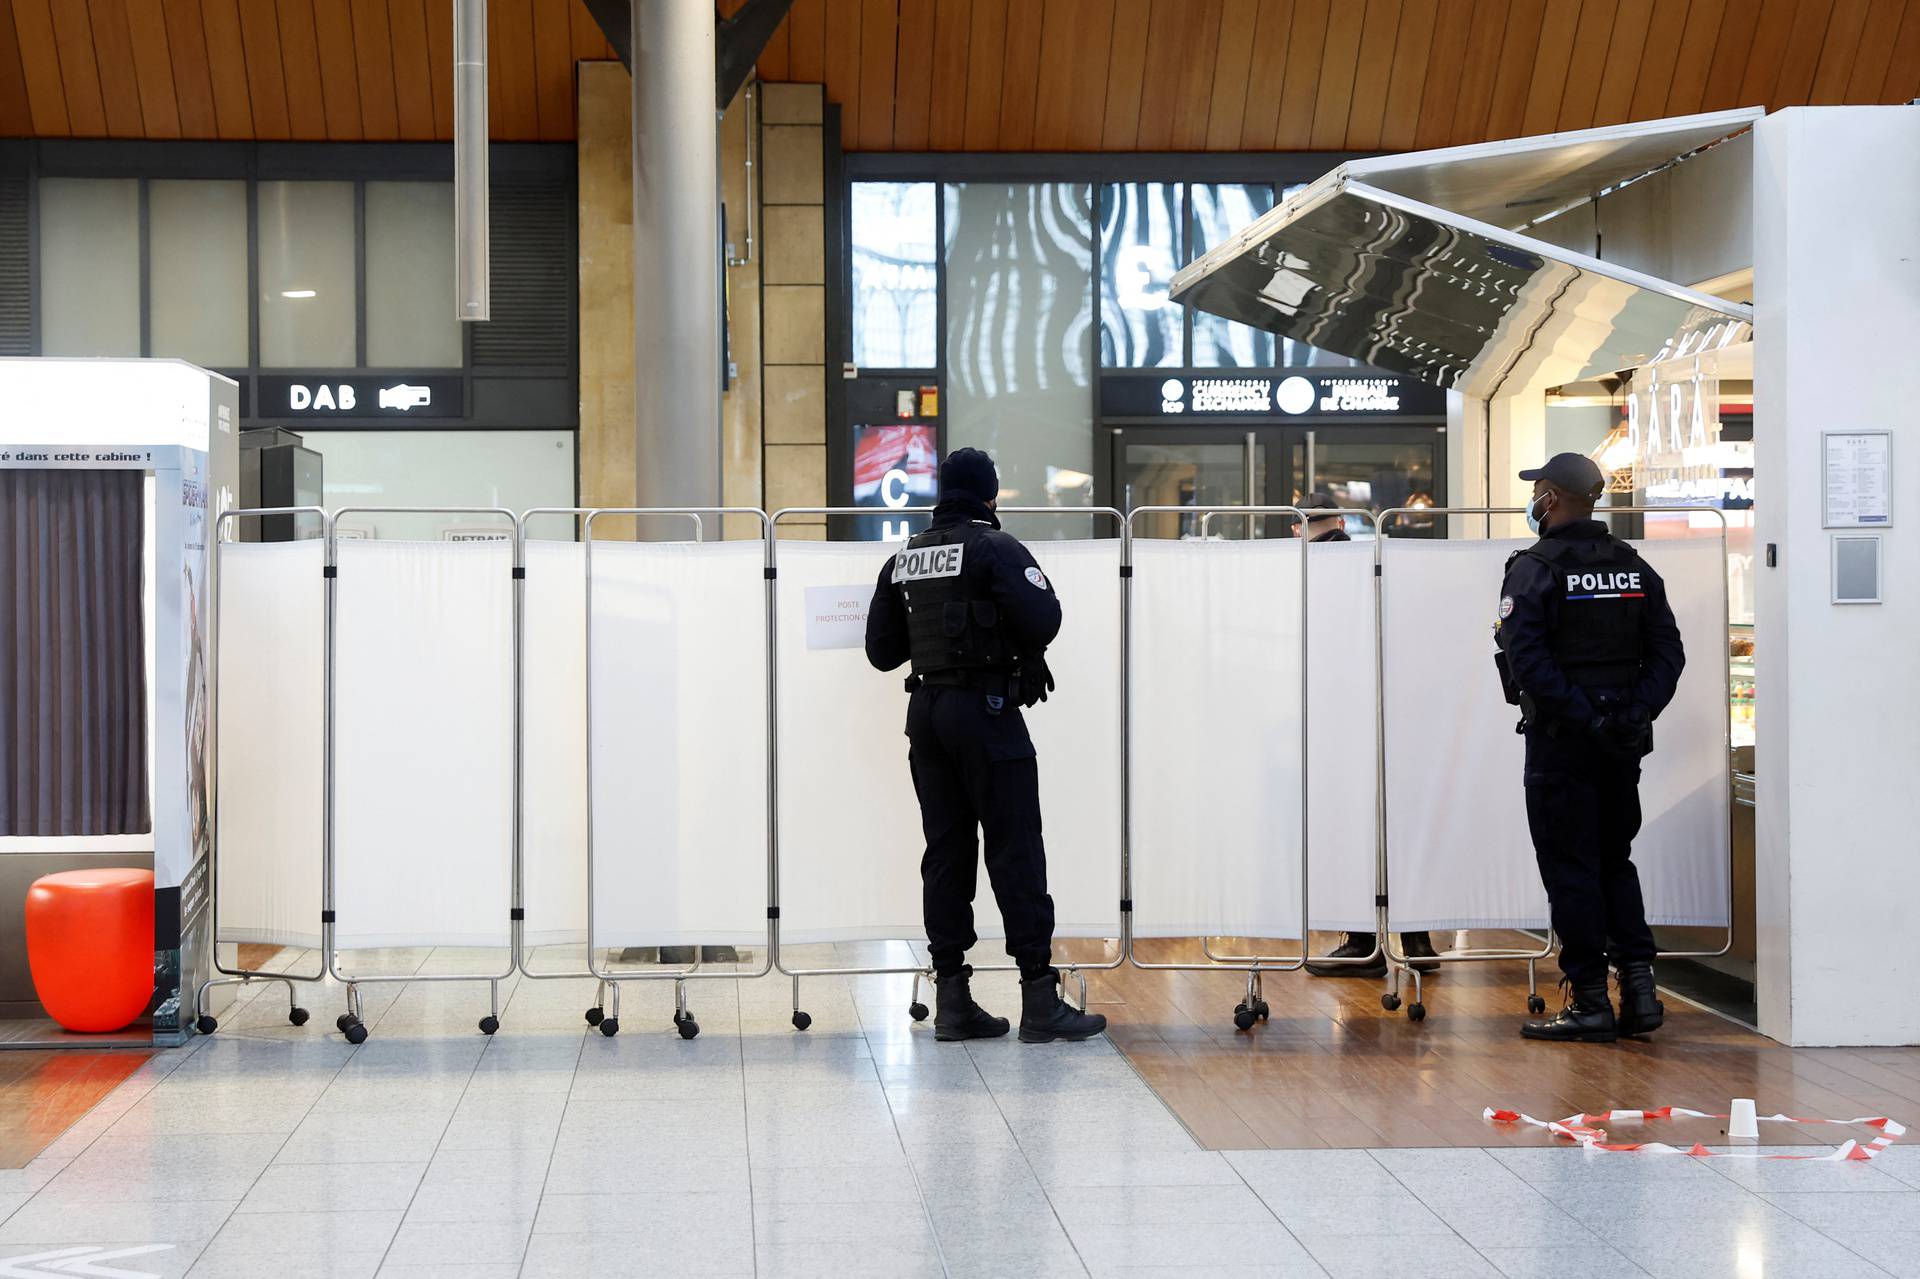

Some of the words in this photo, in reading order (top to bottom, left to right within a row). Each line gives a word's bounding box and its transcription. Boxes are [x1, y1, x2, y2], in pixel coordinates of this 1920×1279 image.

[290, 384, 356, 410] DAB
[16, 452, 48, 461] dans
[54, 453, 90, 461] cette
[95, 452, 141, 461] cabine
[146, 452, 151, 461] !
[895, 548, 960, 577] POLICE
[1566, 572, 1641, 592] POLICE
[837, 601, 862, 609] POSTE
[815, 614, 860, 622] PROTECTION
